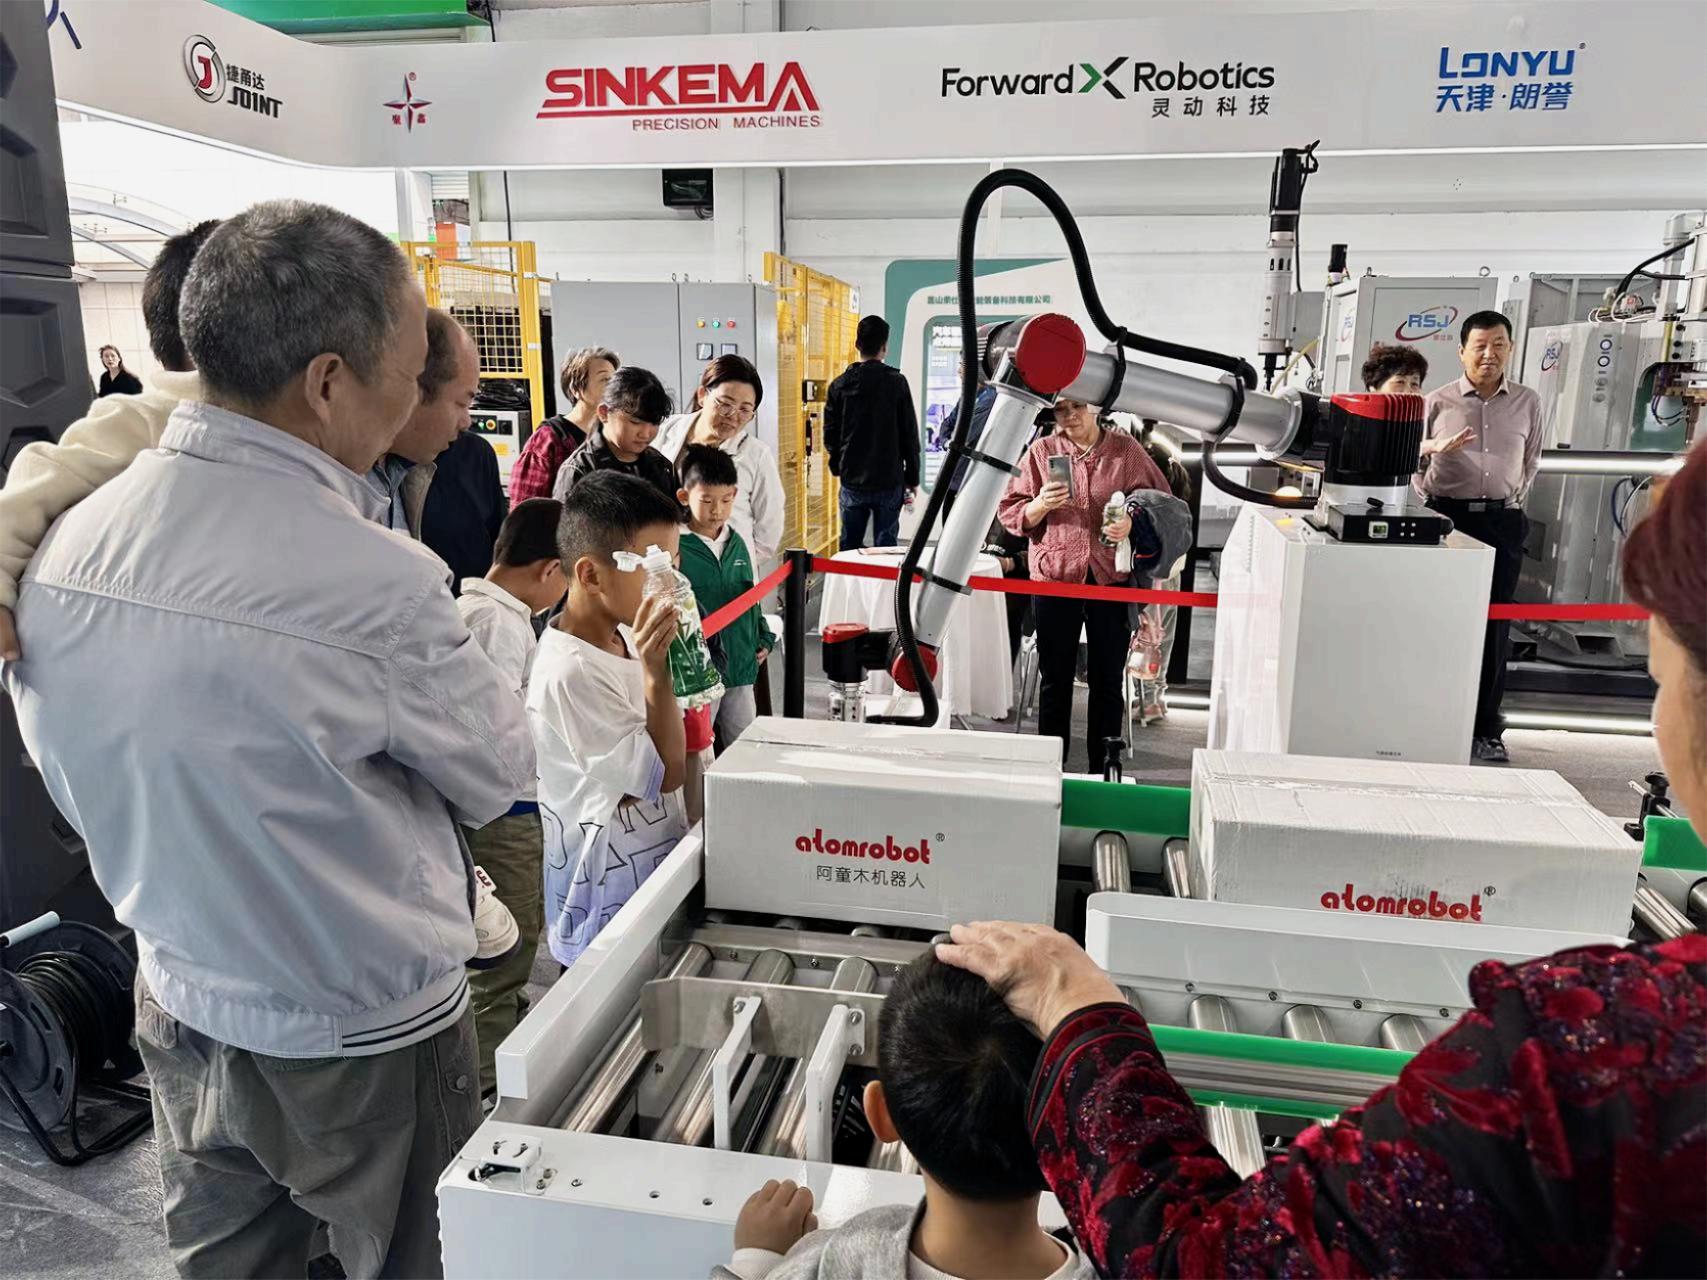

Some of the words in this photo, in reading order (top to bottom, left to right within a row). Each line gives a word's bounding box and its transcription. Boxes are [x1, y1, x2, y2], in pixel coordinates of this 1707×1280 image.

[1133, 61, 1275, 93] Robotics
[1439, 46, 1575, 79] LONYU
[226, 86, 284, 119] JOINT
[541, 61, 821, 113] SINKEMA
[1436, 82, 1574, 113] 天津·朗誉
[1151, 94, 1271, 118] 灵动科技
[632, 118, 719, 131] PRECISION
[732, 115, 822, 130] MACHINES
[1407, 313, 1450, 329] RSJ
[795, 828, 930, 865] atomrobot
[816, 865, 926, 889] 阿童木机器人
[1320, 883, 1483, 922] atomrobot
